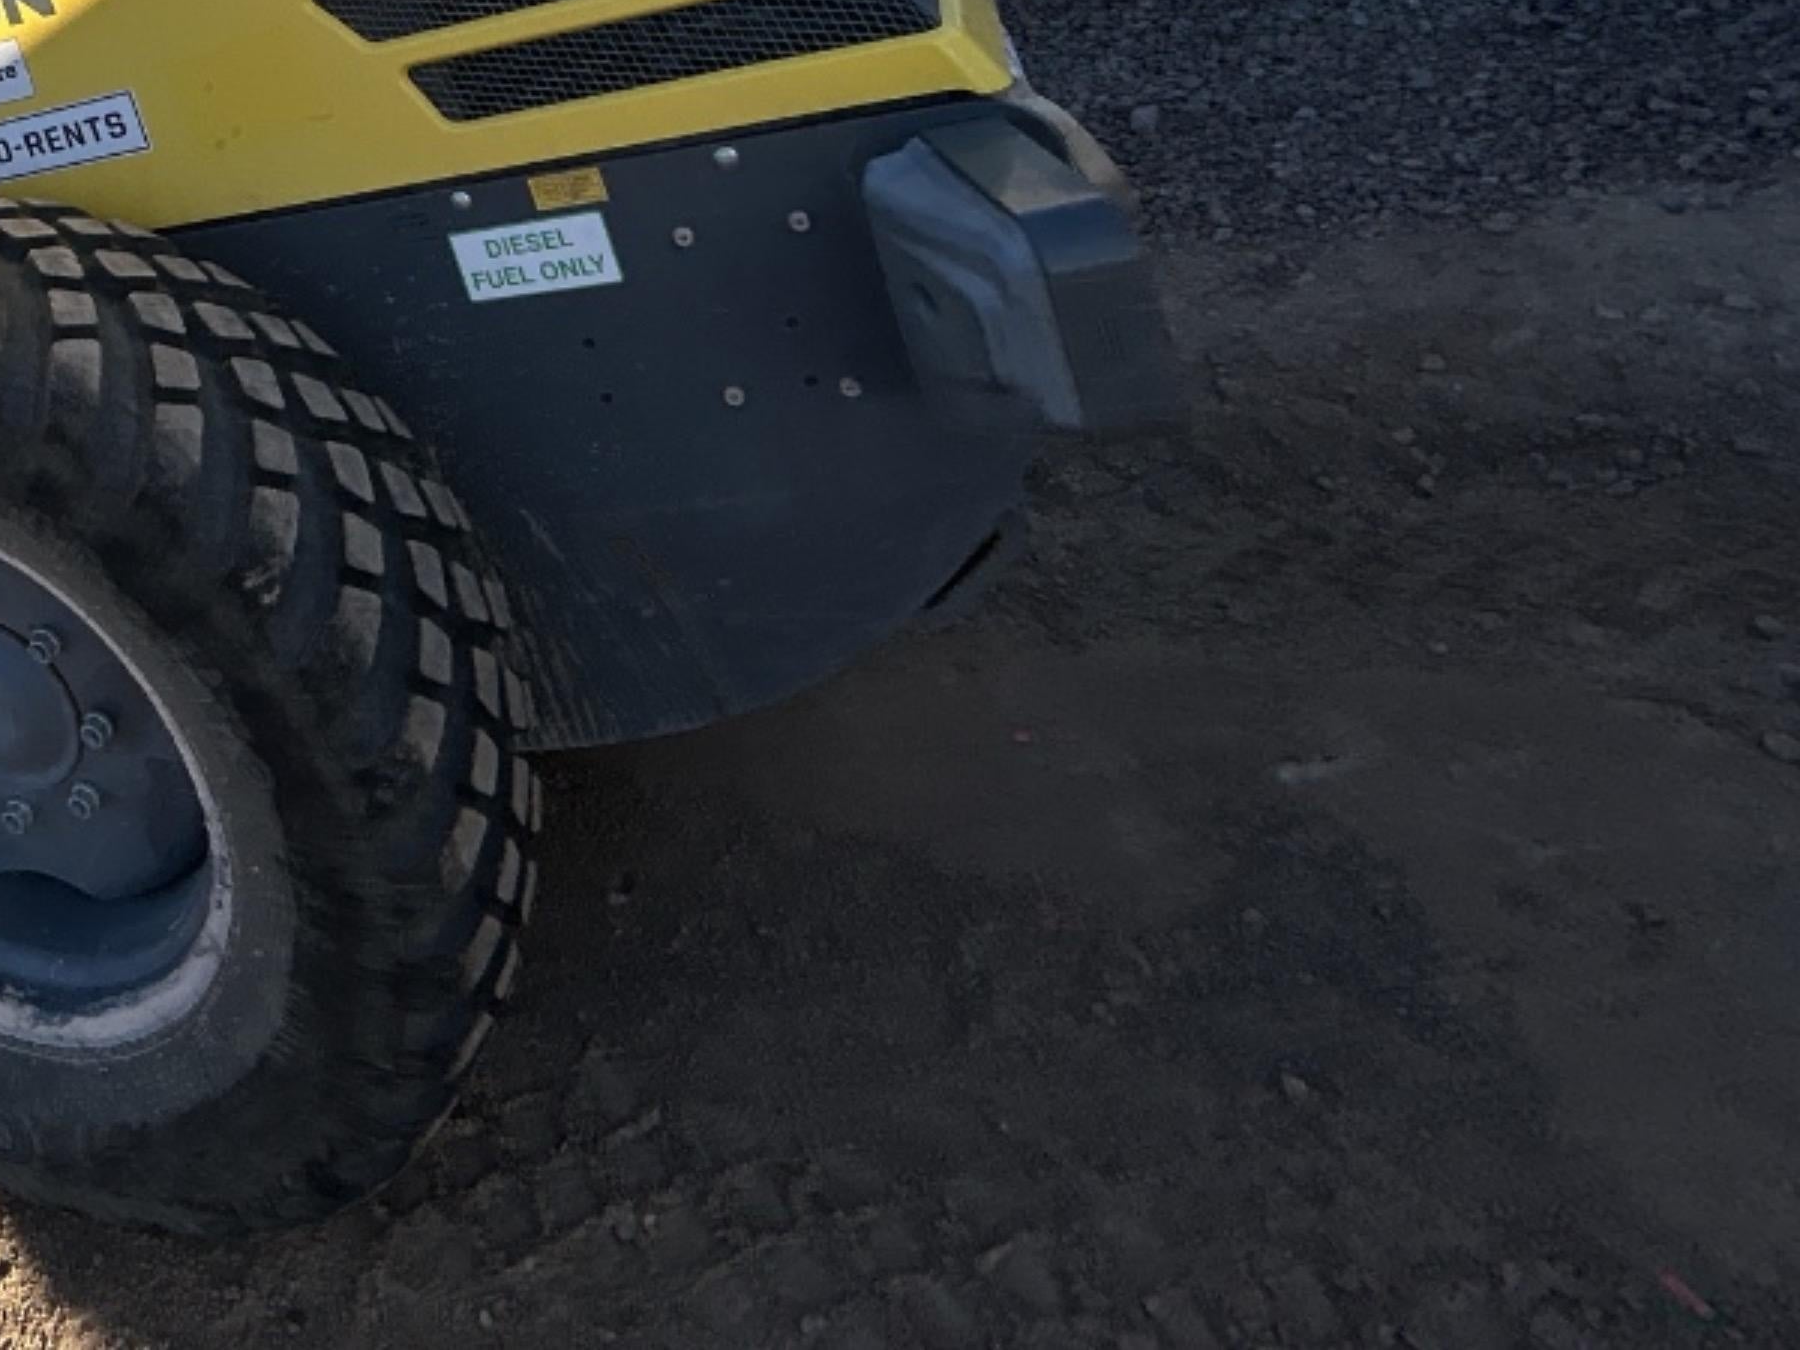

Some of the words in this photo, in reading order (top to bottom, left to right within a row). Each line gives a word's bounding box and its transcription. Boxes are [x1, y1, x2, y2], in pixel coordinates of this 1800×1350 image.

[483, 226, 575, 259] DIESEL
[470, 265, 536, 292] FUEL
[539, 254, 605, 281] ONLY
